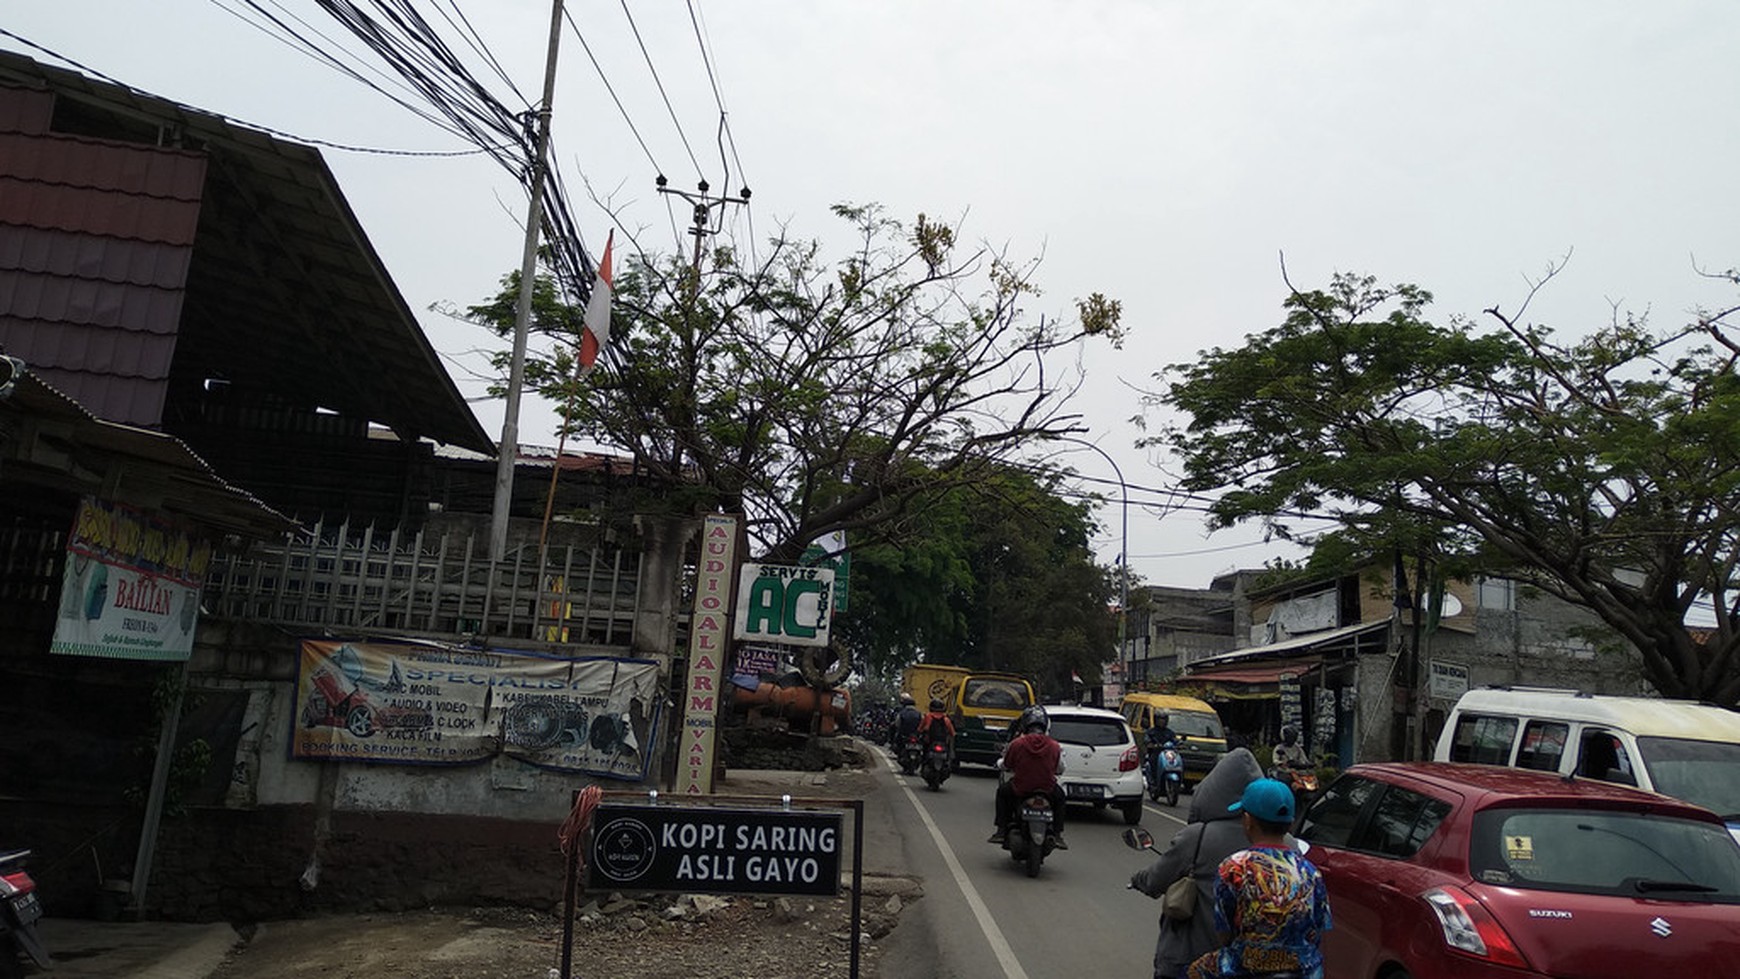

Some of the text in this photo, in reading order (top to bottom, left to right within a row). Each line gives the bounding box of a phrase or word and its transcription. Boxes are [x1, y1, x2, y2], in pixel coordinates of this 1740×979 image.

[759, 565, 819, 581] SERVIS
[746, 576, 821, 639] AC
[816, 580, 830, 630] MOBIL
[409, 684, 442, 696] MOBIL
[390, 699, 423, 710] AUDIO
[436, 701, 468, 713] VIDEO
[447, 718, 476, 730] LOCK
[386, 730, 442, 742] KACA FILM
[301, 742, 359, 755] BOOKING
[362, 744, 417, 756] SERVICE
[661, 822, 836, 853] KOPI SARING
[676, 855, 819, 884] ASLI GAYO
[1529, 908, 1573, 920] SUZUKI
